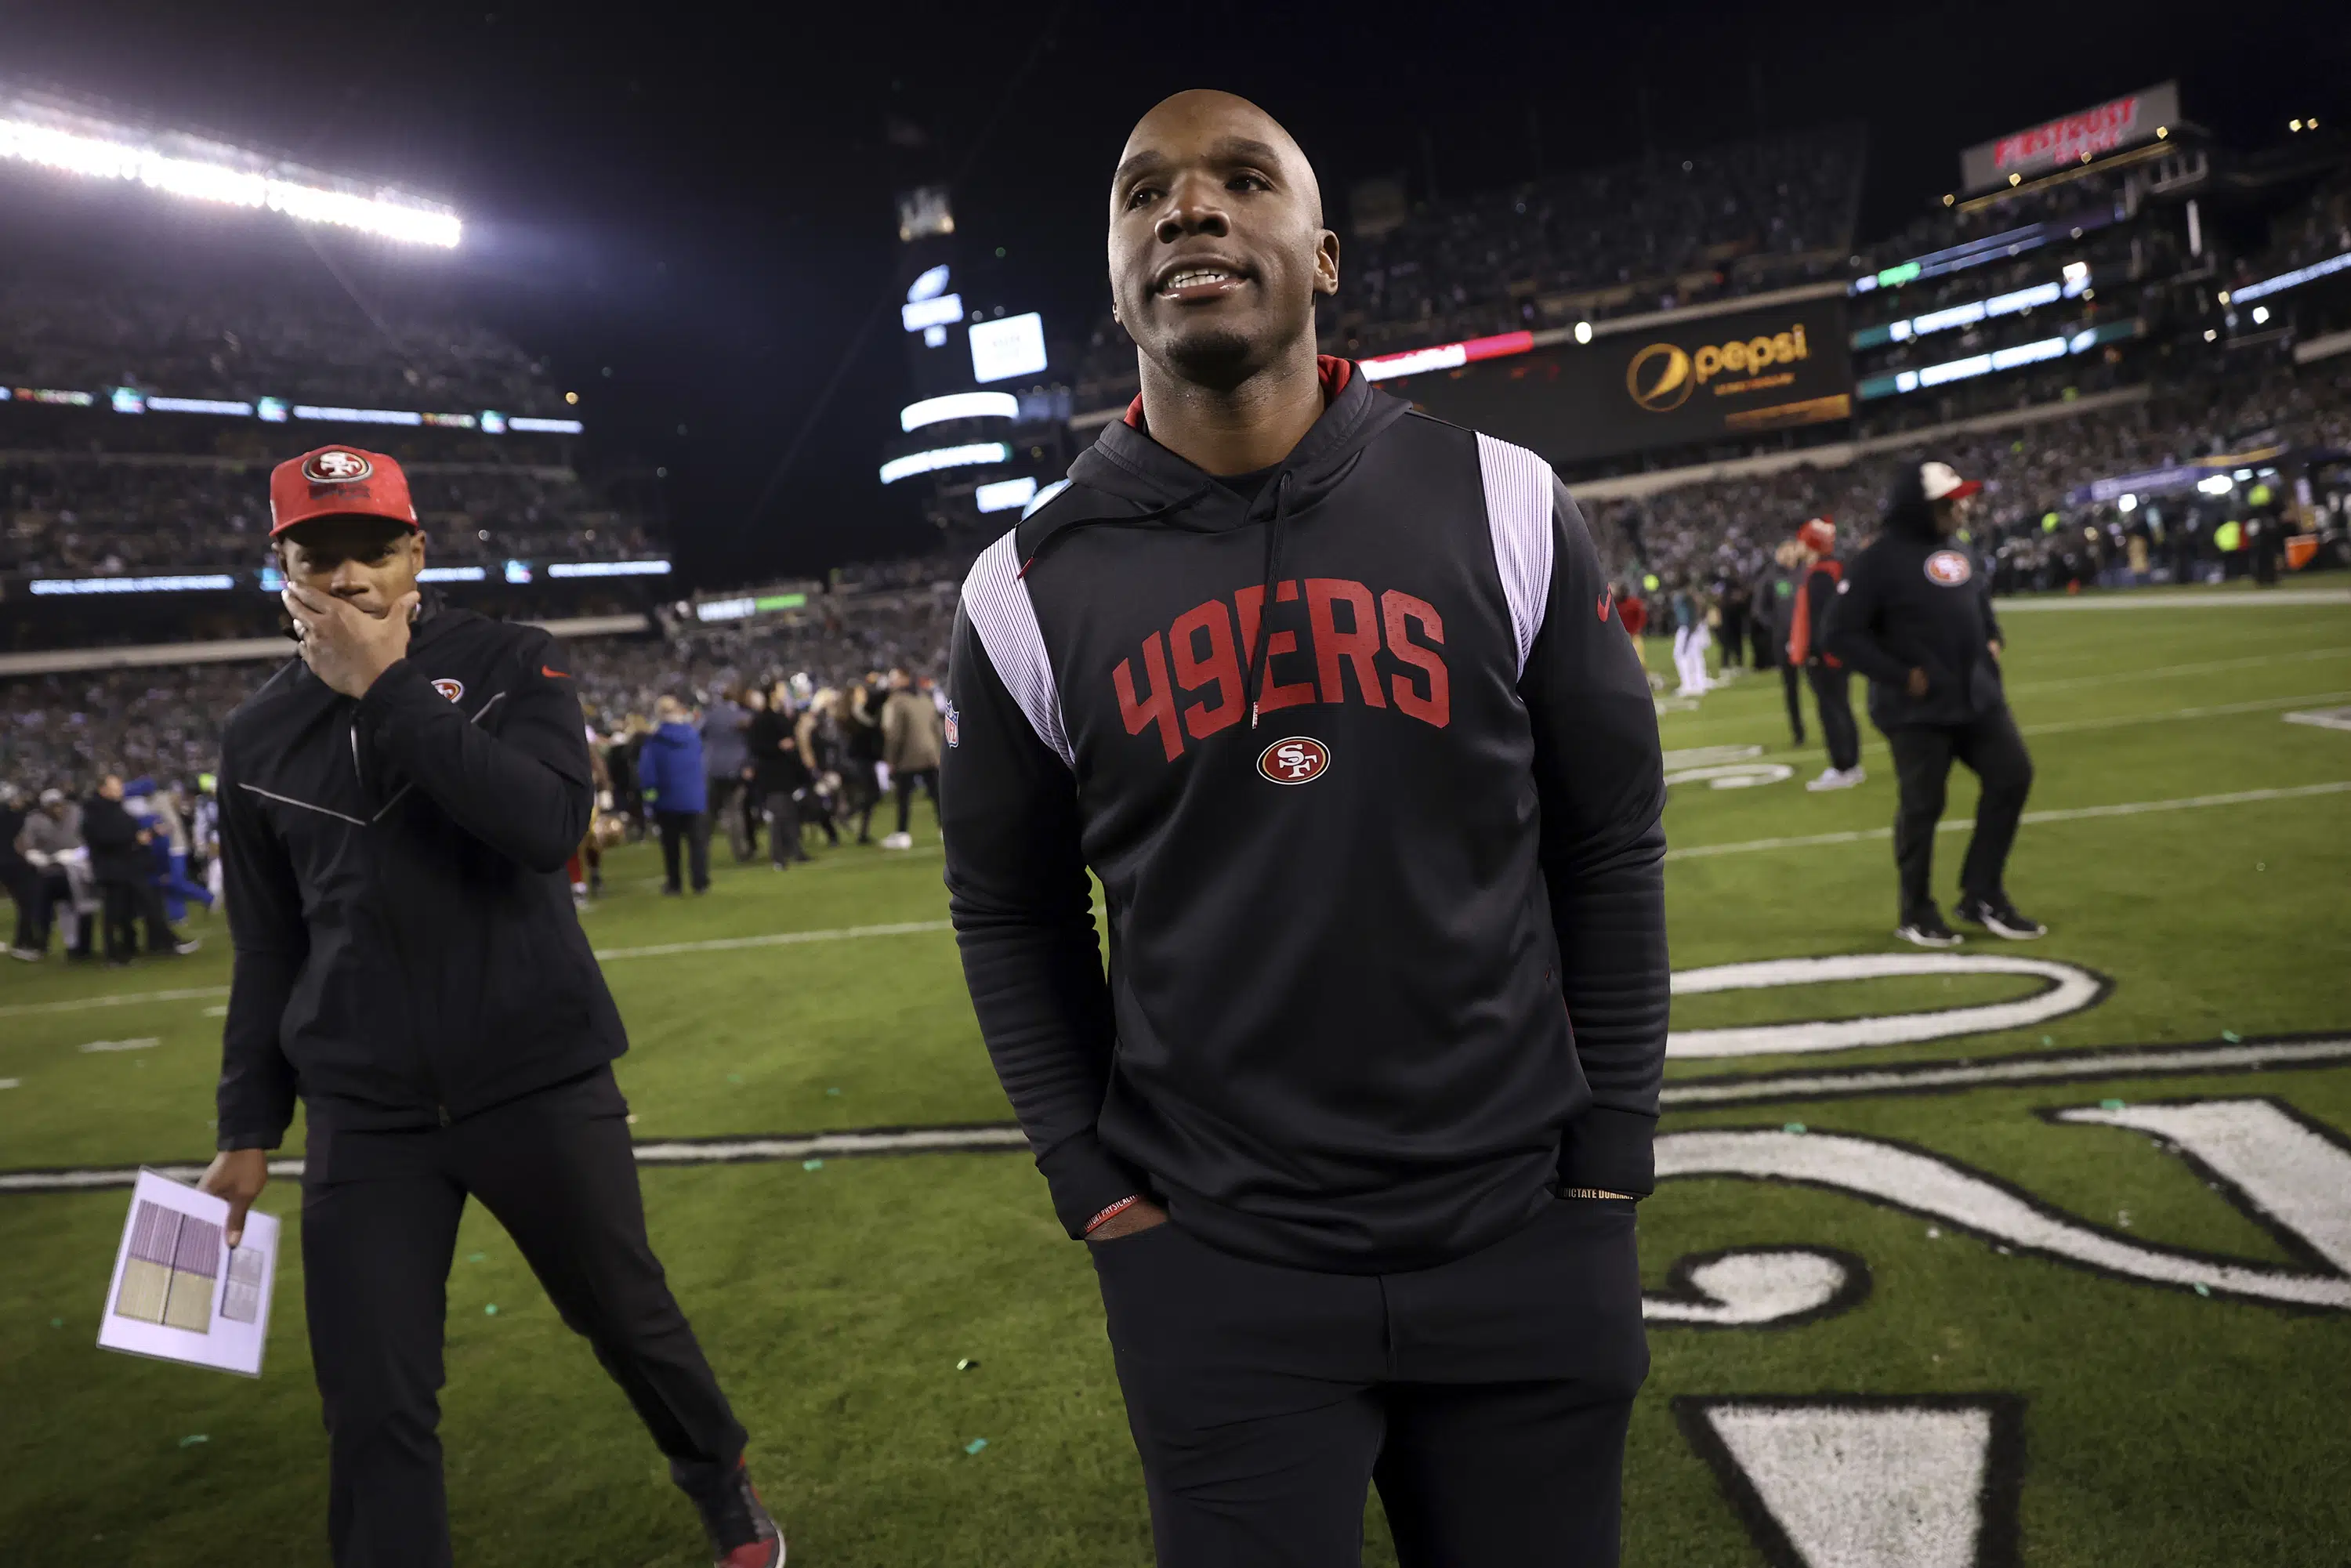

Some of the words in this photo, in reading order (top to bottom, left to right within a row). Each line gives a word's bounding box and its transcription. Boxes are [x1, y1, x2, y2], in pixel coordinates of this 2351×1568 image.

[1694, 323, 1809, 384] pepsi
[1112, 578, 1451, 763] 49ERS
[1277, 743, 1318, 778] SF
